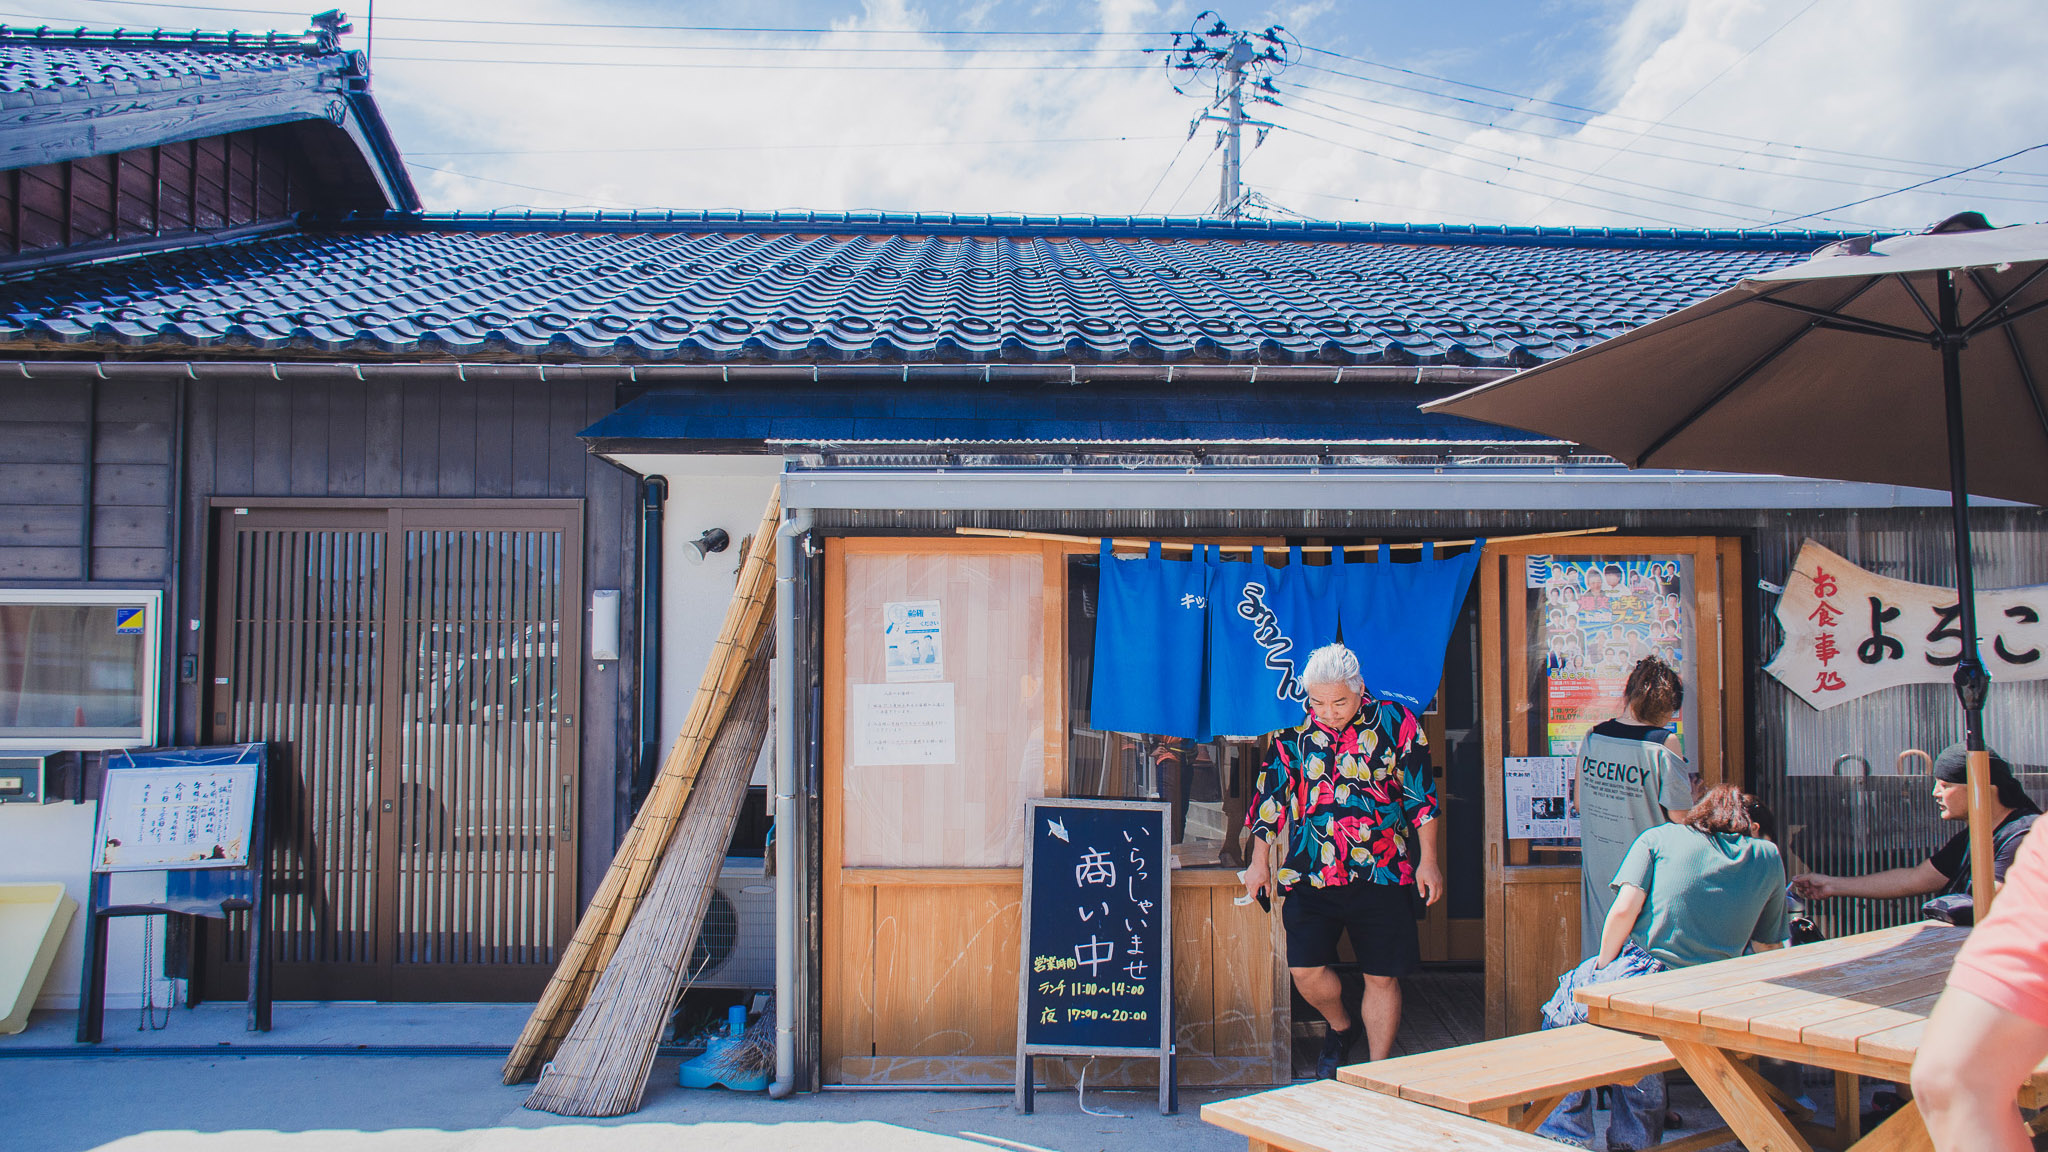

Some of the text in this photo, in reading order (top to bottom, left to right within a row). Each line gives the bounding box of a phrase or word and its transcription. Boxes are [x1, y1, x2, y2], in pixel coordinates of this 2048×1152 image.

[1611, 610, 1651, 625] フェス
[1808, 565, 1847, 694] お食事処
[1857, 596, 2040, 666] よろこ
[1583, 756, 1650, 787] DECENCY
[1075, 846, 1116, 977] 商い中
[1123, 827, 1153, 979] いらっしゃいませ
[1034, 955, 1077, 973] 営業時間
[1038, 979, 1066, 996] ランチ
[1040, 1006, 1058, 1024] 夜
